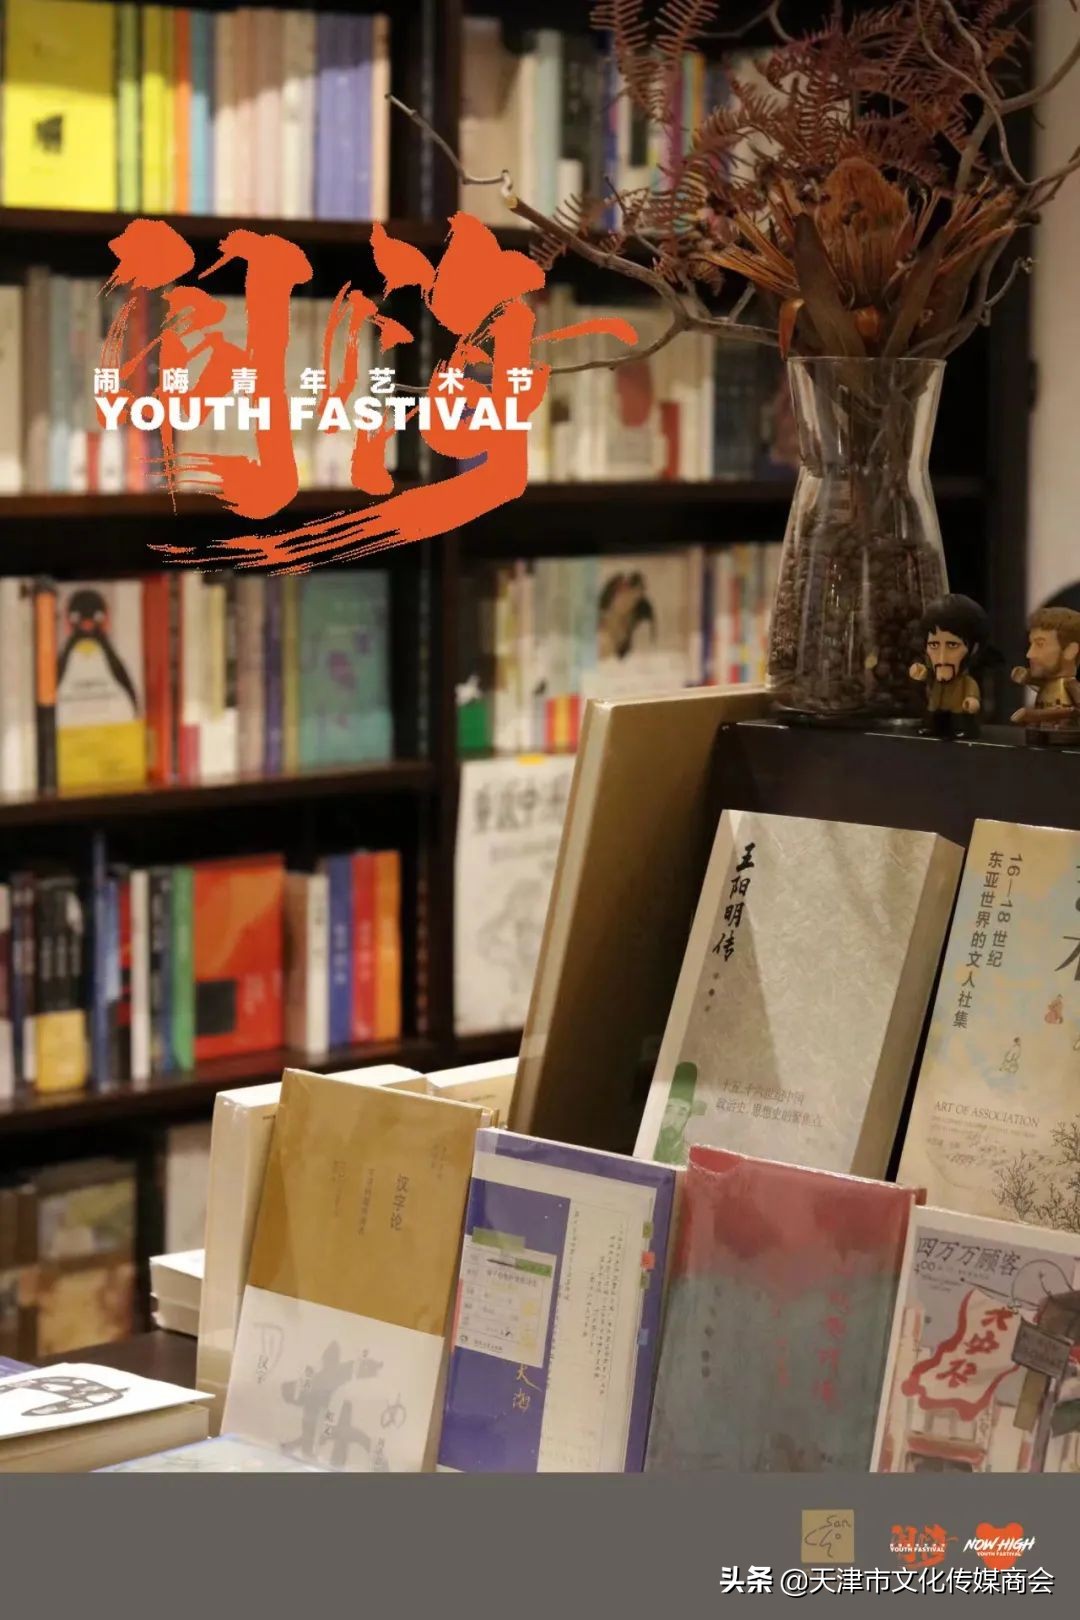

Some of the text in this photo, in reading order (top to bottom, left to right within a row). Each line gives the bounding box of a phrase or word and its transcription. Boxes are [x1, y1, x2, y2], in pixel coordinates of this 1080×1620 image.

[712, 842, 756, 962] 王阳明传
[952, 850, 1004, 1029] 东亚世界的文人社集
[934, 1101, 953, 1113] ART
[955, 1104, 970, 1115] OF
[971, 1107, 1039, 1128] ASSOCIATION
[917, 1236, 1021, 1277] 四万万顾客
